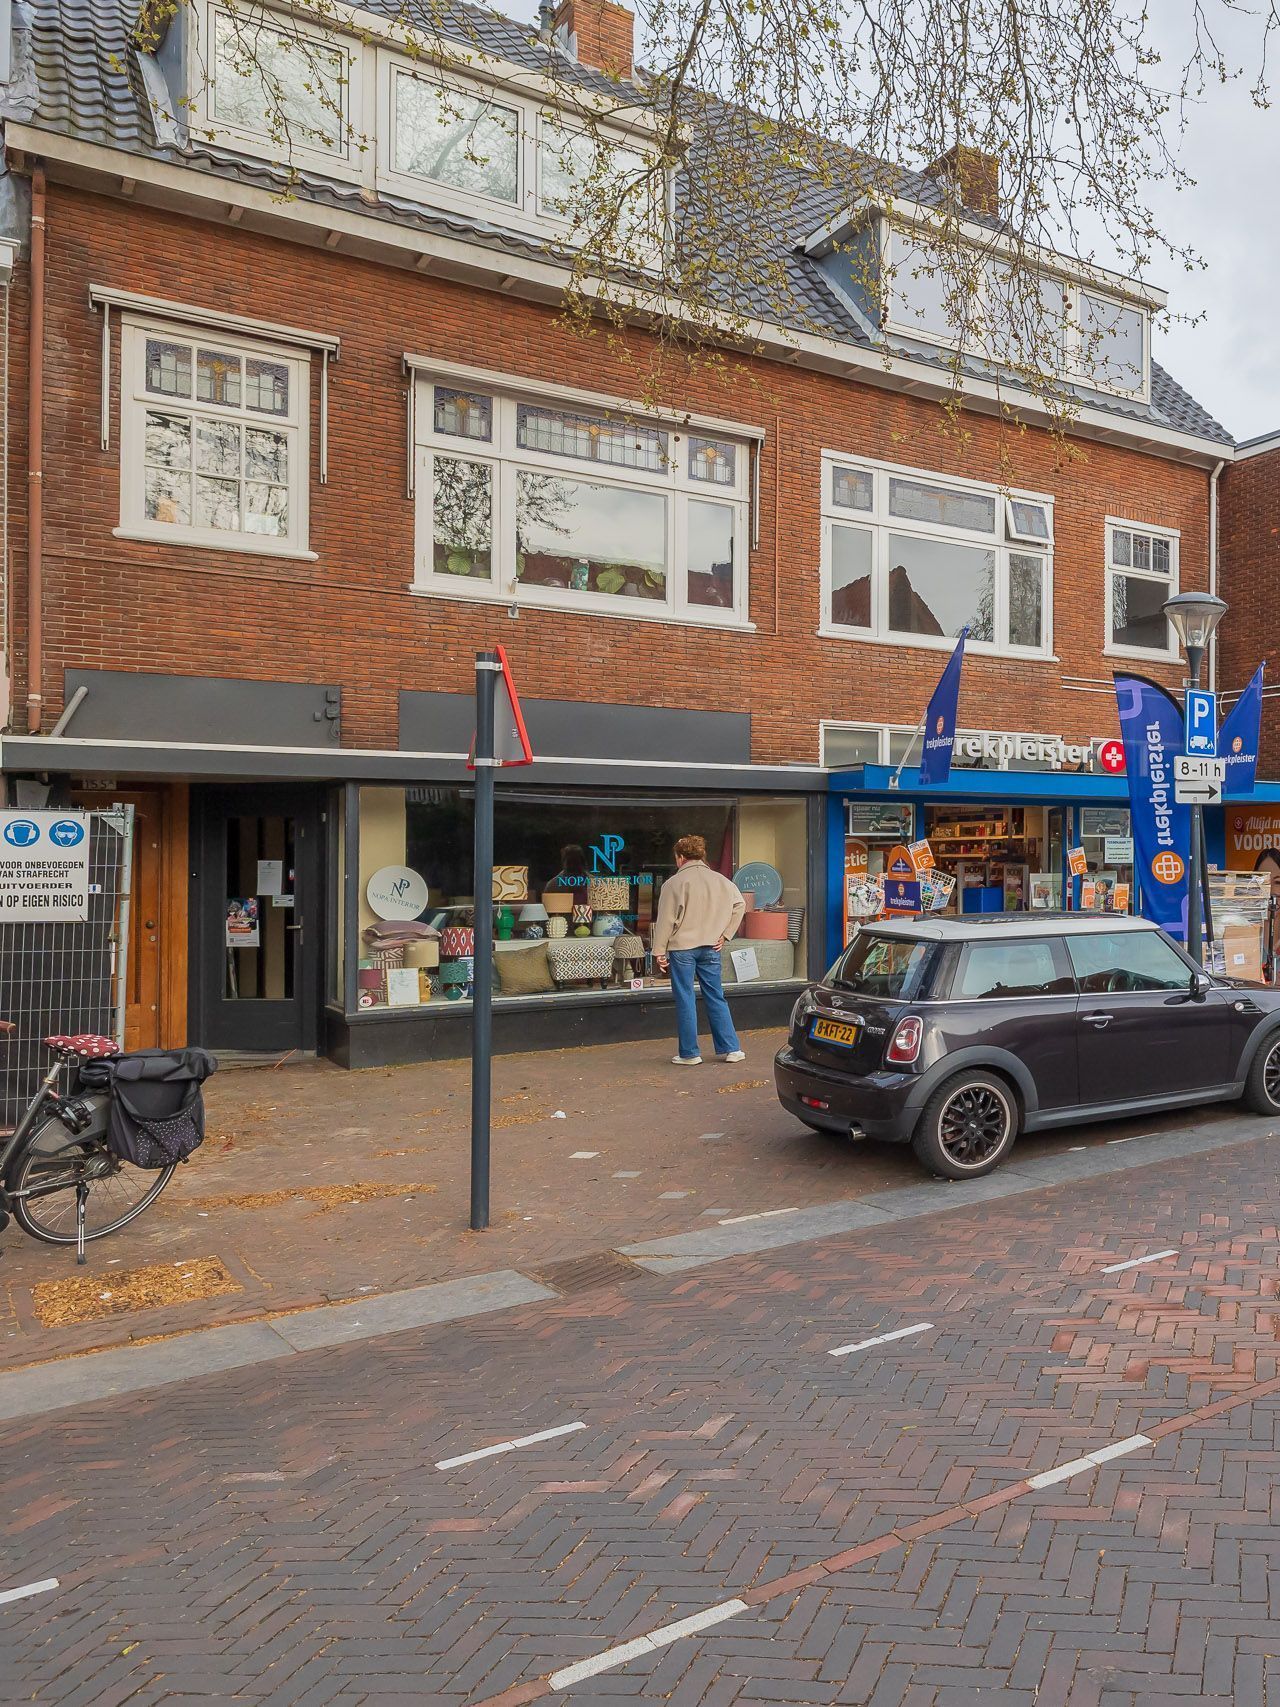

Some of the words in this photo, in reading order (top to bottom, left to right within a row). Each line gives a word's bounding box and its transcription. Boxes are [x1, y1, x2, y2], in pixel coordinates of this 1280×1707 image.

[1194, 698, 1209, 728] P
[926, 735, 954, 751] trekpleister
[952, 734, 1091, 766] rekpleister
[1219, 753, 1256, 766] ekpleister
[1214, 763, 1221, 777] h
[1146, 720, 1174, 846] trekpleister
[1245, 816, 1270, 833] Altijd
[0, 861, 22, 869] VOOR
[25, 861, 84, 869] ONBEVOEGDEN
[844, 850, 868, 867] ctie
[16, 870, 69, 878] STRAFRECHT
[557, 875, 591, 887] NOPA
[594, 874, 654, 885] INTERIOR
[6, 895, 19, 907] OP
[22, 895, 50, 907] EIGEN
[53, 894, 84, 907] RISICO
[817, 1021, 853, 1041] 8-KFT-22
